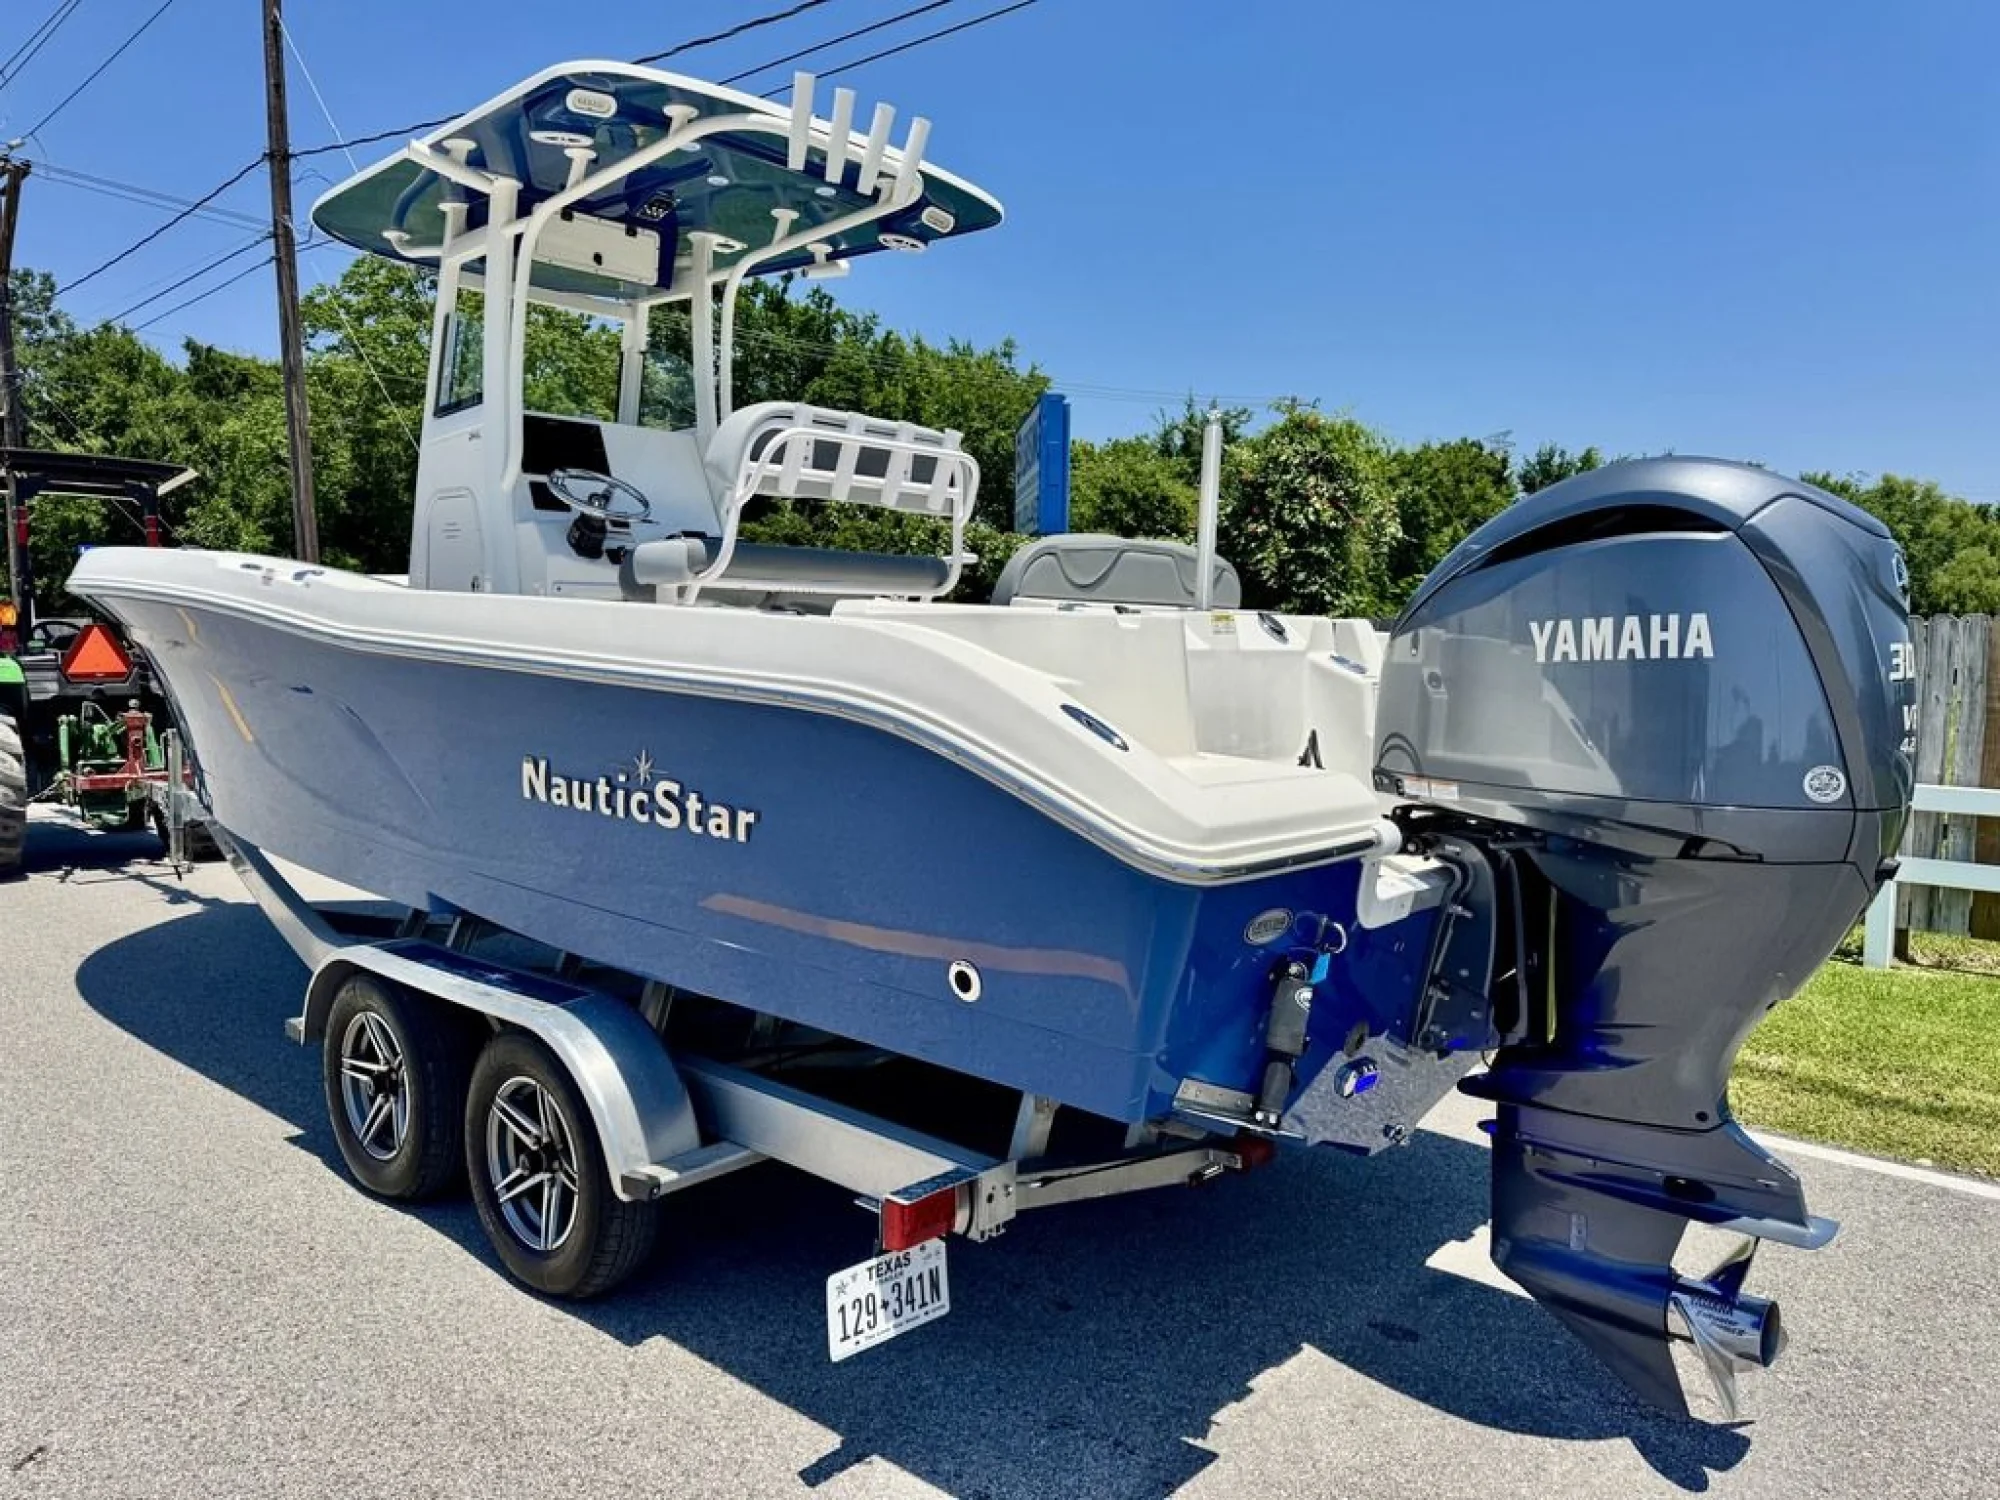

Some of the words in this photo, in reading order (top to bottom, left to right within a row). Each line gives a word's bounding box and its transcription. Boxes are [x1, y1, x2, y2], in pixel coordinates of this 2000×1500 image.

[1529, 612, 1714, 663] YAMAHA
[522, 756, 756, 843] NauticStar
[866, 1252, 911, 1282] TEXAS
